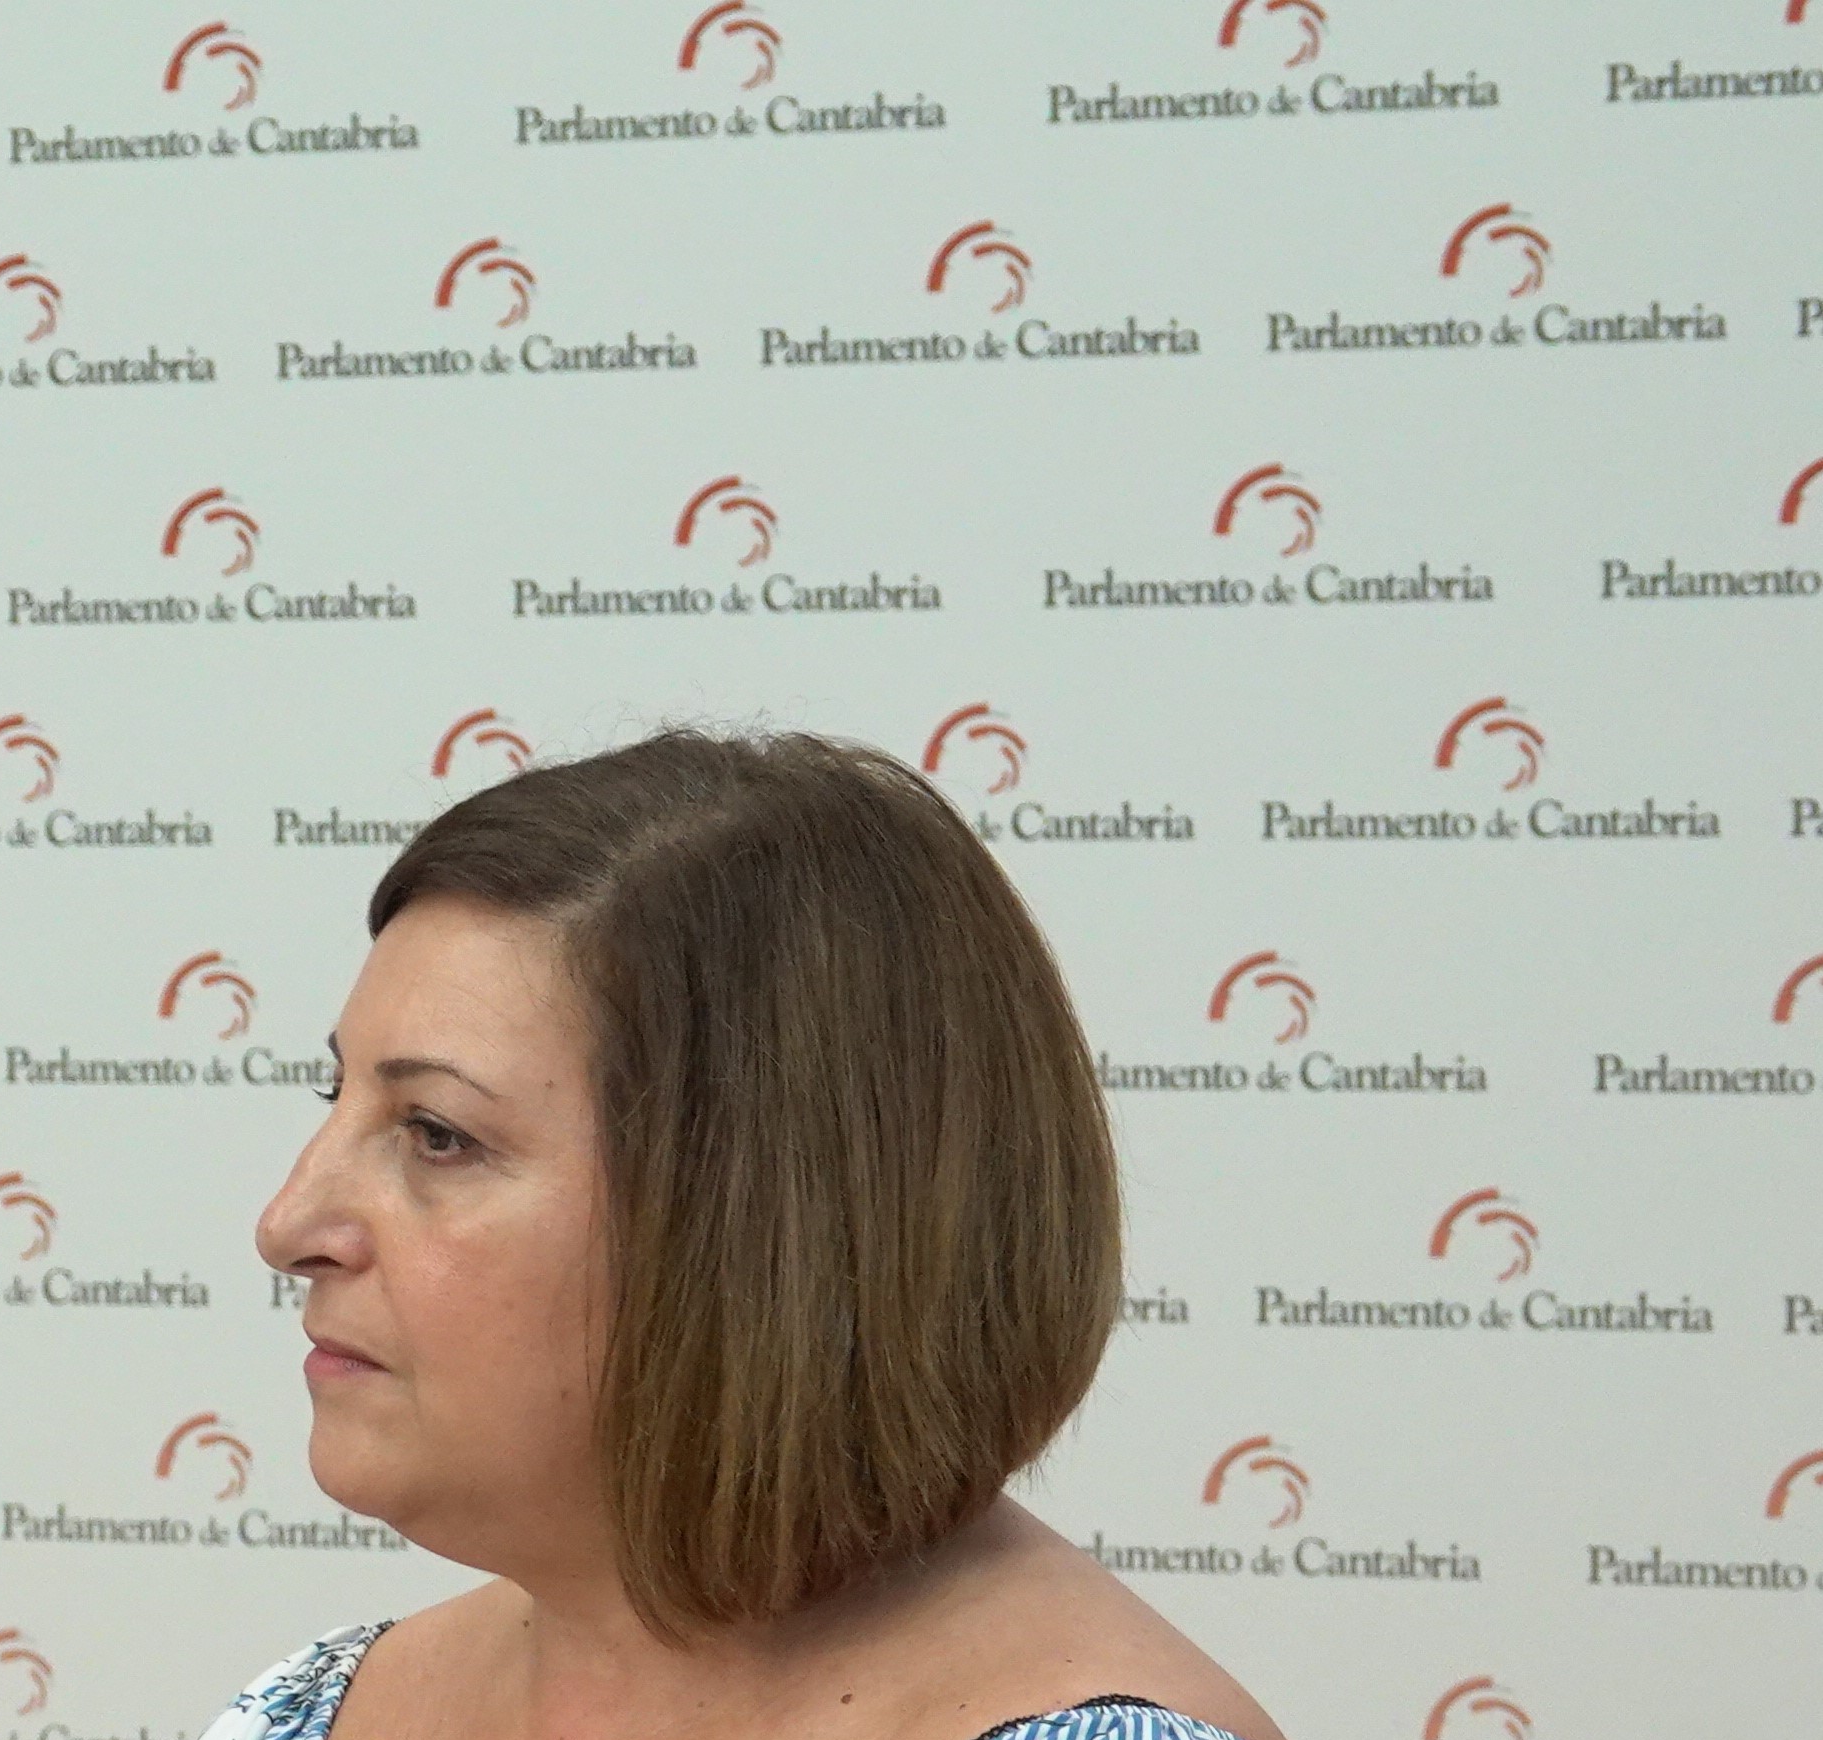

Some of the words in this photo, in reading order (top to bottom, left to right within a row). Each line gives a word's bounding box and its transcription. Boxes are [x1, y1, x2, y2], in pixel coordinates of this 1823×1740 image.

[1047, 82, 1260, 125] Parlamento
[1266, 84, 1302, 116] de
[1310, 69, 1499, 115] Cantabria
[1606, 60, 1823, 103] Parlamento
[9, 125, 202, 165] Parlamento
[208, 126, 240, 158] de
[246, 112, 420, 155] Cantabria
[516, 104, 719, 146] Parlamento
[724, 107, 758, 138] de
[765, 91, 946, 135] Cantabria
[760, 326, 966, 367] Parlamento
[974, 330, 1008, 361] de
[1015, 316, 1200, 360] Cantabria
[1267, 311, 1483, 353] Parlamento
[1490, 316, 1525, 347] de
[1533, 301, 1727, 346] Cantabria
[9, 356, 40, 388] de
[46, 345, 216, 387] Cantabria
[277, 340, 474, 380] Parlamento
[479, 345, 512, 375] de
[519, 331, 697, 374] Cantabria
[513, 577, 714, 618] Parlamento
[721, 583, 754, 615] de
[761, 572, 941, 614] Cantabria
[1044, 567, 1255, 609] Parlamento
[1262, 575, 1297, 606] de
[1304, 562, 1494, 605] Cantabria
[1601, 558, 1823, 600] Parlamento
[8, 587, 200, 626] Parlamento
[206, 593, 237, 622] de
[244, 582, 416, 622] Cantabria
[7, 819, 36, 848] de
[44, 808, 213, 848] Cantabria
[1010, 802, 1195, 842] Cantabria
[1262, 799, 1476, 841] Parlamento
[1485, 808, 1520, 839] de
[1528, 799, 1721, 839] Cantabria
[6, 1047, 196, 1085] Parlamento
[203, 1056, 233, 1085] de
[1256, 1061, 1291, 1092] de
[1299, 1051, 1488, 1093] Cantabria
[1594, 1054, 1815, 1095] Parlamento
[4, 1276, 35, 1306] de
[41, 1268, 210, 1308] Cantabria
[1256, 1286, 1471, 1329] Parlamento
[1478, 1298, 1512, 1330] de
[1521, 1290, 1714, 1333] Cantabria
[2, 1503, 193, 1544] Parlamento
[199, 1517, 230, 1547] de
[1251, 1545, 1284, 1577] de
[1292, 1537, 1481, 1582] Cantabria
[1588, 1544, 1808, 1592] Parlamento
